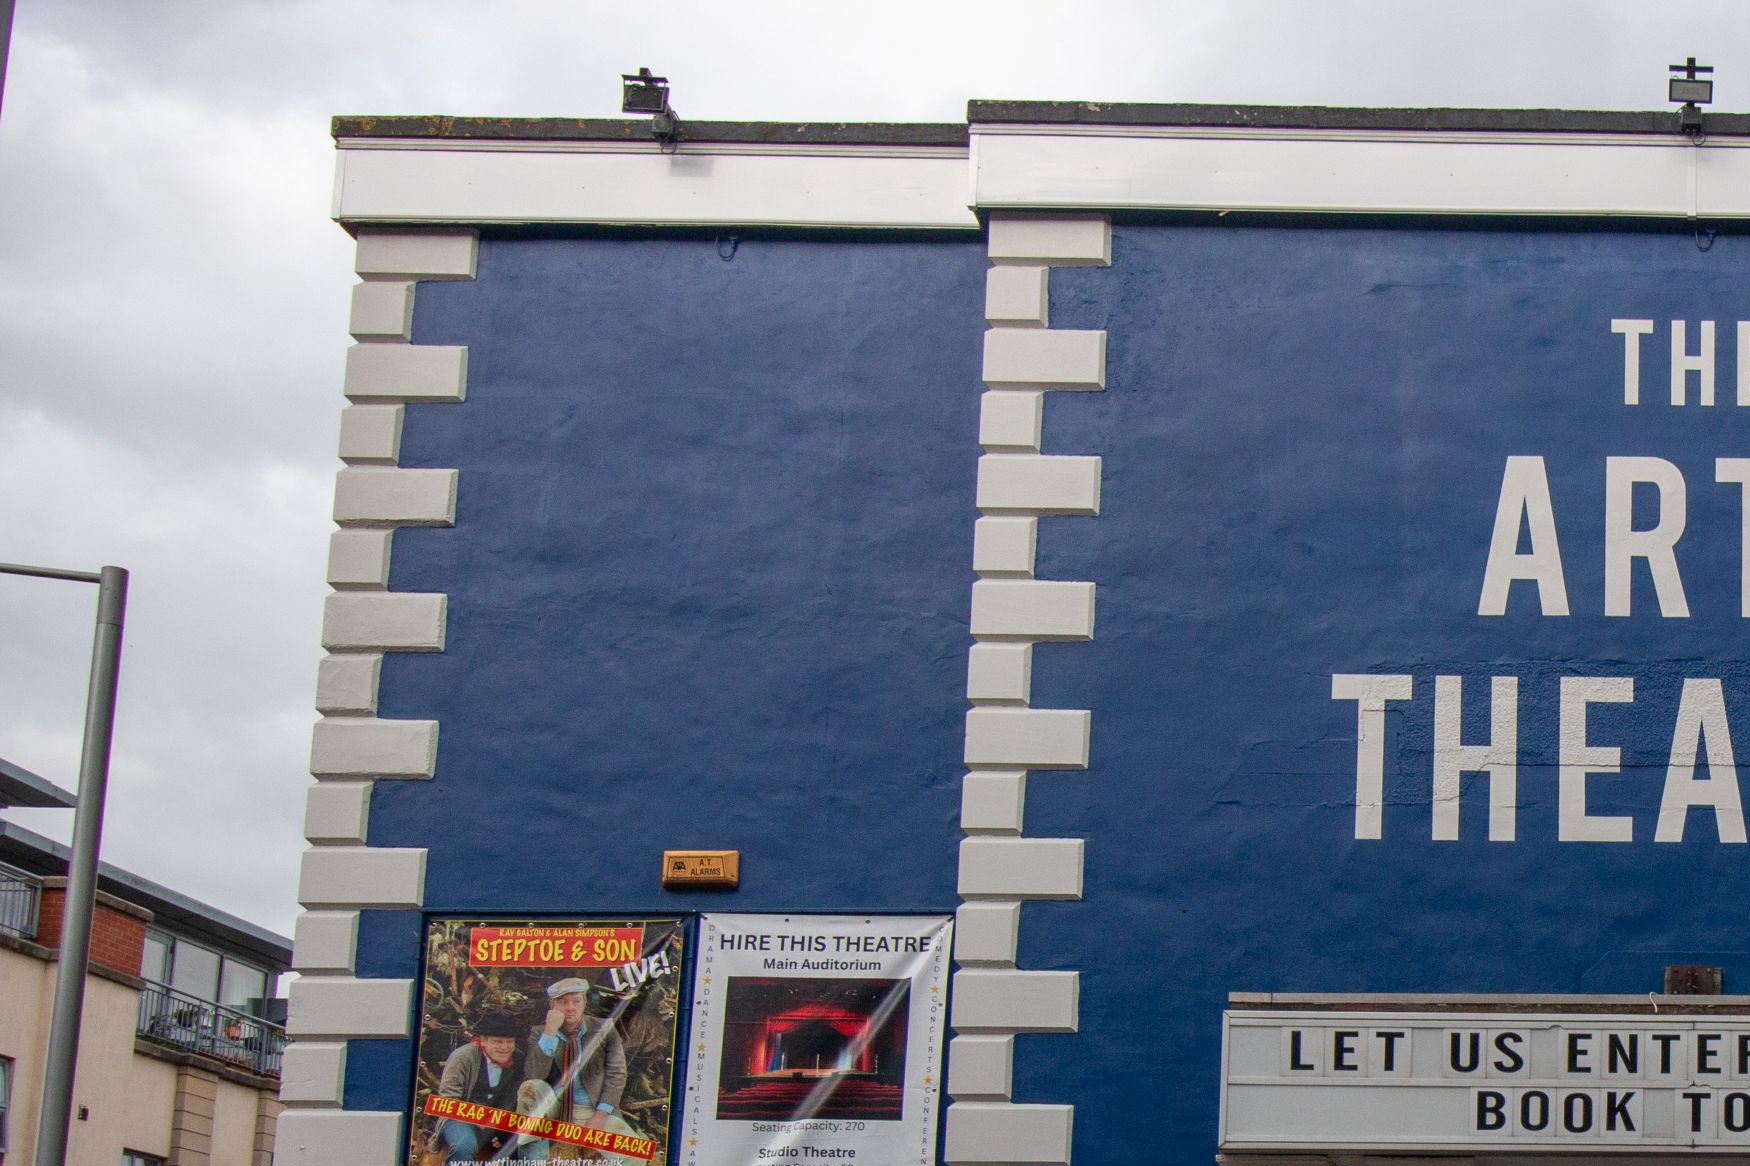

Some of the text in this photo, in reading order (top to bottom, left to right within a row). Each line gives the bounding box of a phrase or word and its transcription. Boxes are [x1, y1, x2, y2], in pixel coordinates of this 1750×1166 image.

[690, 867, 721, 876] ALARMS
[553, 928, 573, 937] ALAN
[475, 938, 637, 962] STEPTOE & SON
[720, 933, 932, 953] HIRE THIS THEATRE
[609, 950, 671, 992] LIVE!
[763, 958, 881, 971] Main Auditorium
[1290, 1030, 1407, 1072] LET
[1448, 1030, 1526, 1074] US
[1475, 1089, 1638, 1133] BOOK
[432, 1097, 454, 1114] THE
[458, 1103, 485, 1120] RAG
[508, 1114, 553, 1134] BONING
[555, 1122, 582, 1140] DUO
[583, 1128, 611, 1146] ARE
[613, 1134, 652, 1155] BACK!
[752, 1121, 865, 1134] Seating Capacity: 270
[758, 1146, 856, 1159] Studio Theatre
